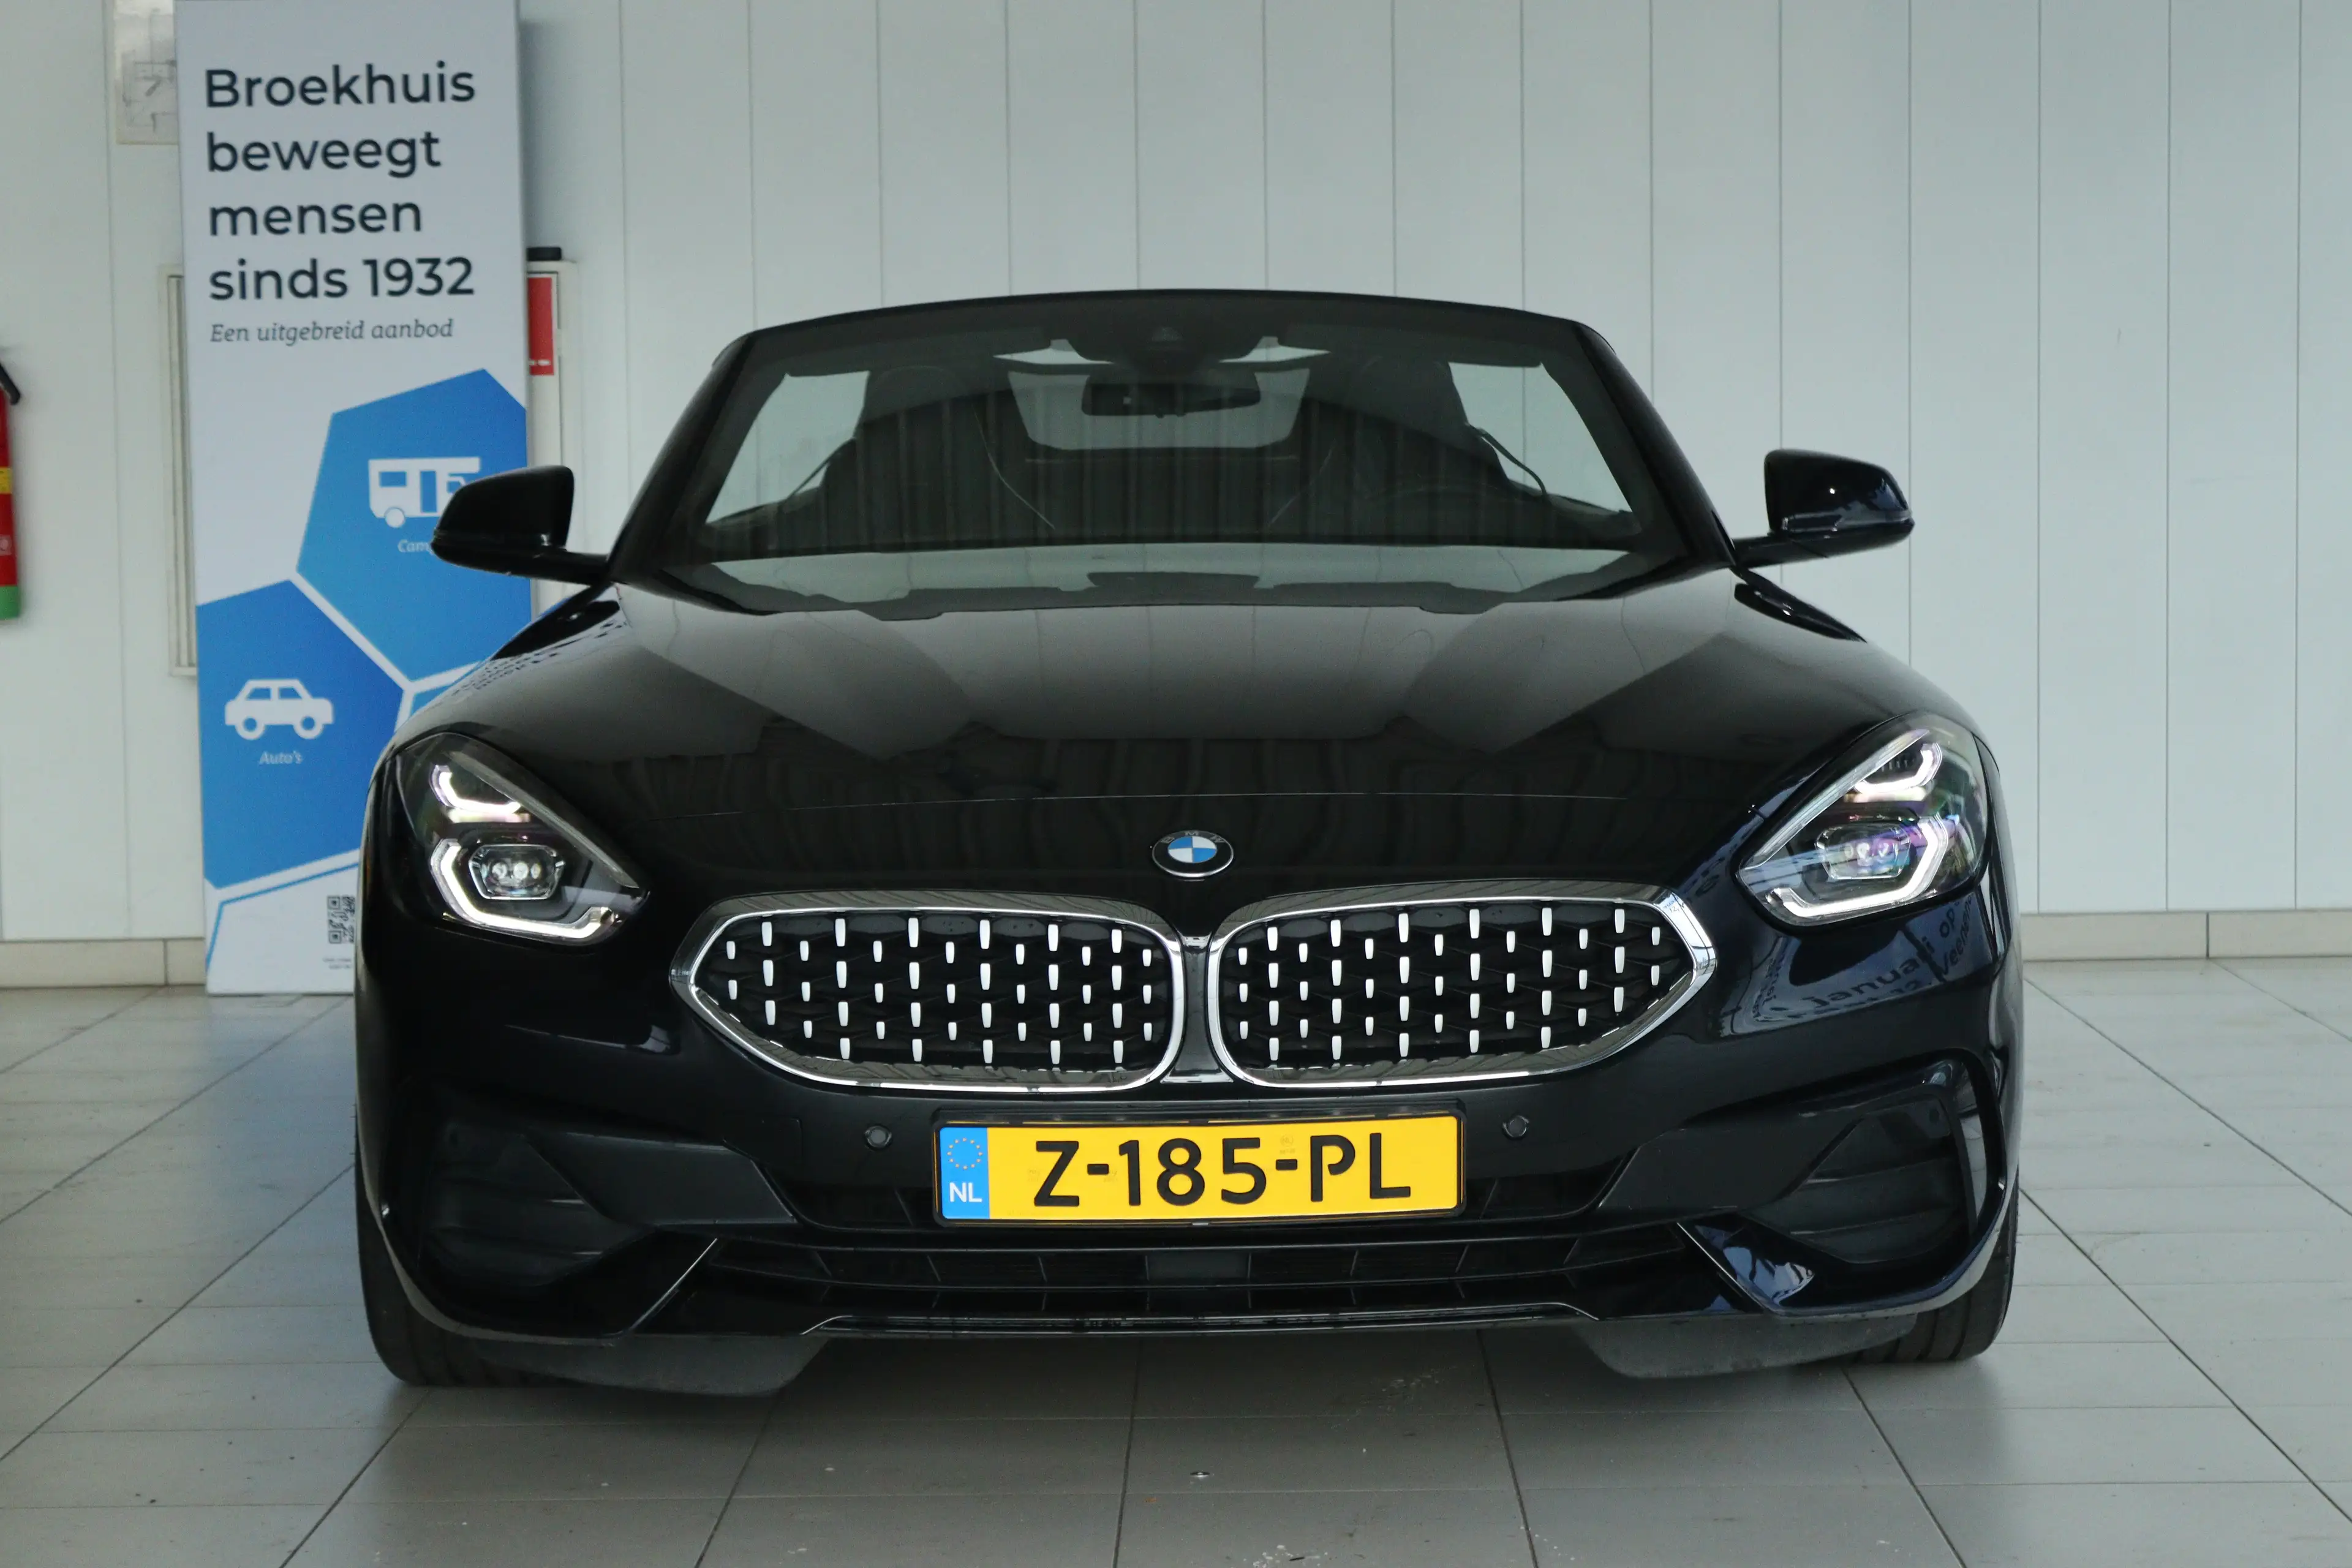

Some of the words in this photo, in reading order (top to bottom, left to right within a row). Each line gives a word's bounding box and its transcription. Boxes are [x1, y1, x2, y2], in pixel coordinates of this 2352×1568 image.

[206, 60, 475, 108] Broekhuis
[207, 131, 442, 179] beweegt
[210, 202, 421, 236] mensen
[209, 258, 348, 301] sinds
[363, 257, 474, 297] 1932
[210, 323, 249, 342] Een
[257, 320, 364, 347] uitgebreid
[371, 318, 453, 339] aanbod
[397, 539, 433, 556] Cam
[260, 750, 303, 764] Auto's
[1033, 1133, 1411, 1207] Z-185-PL
[949, 1182, 982, 1203] NL
